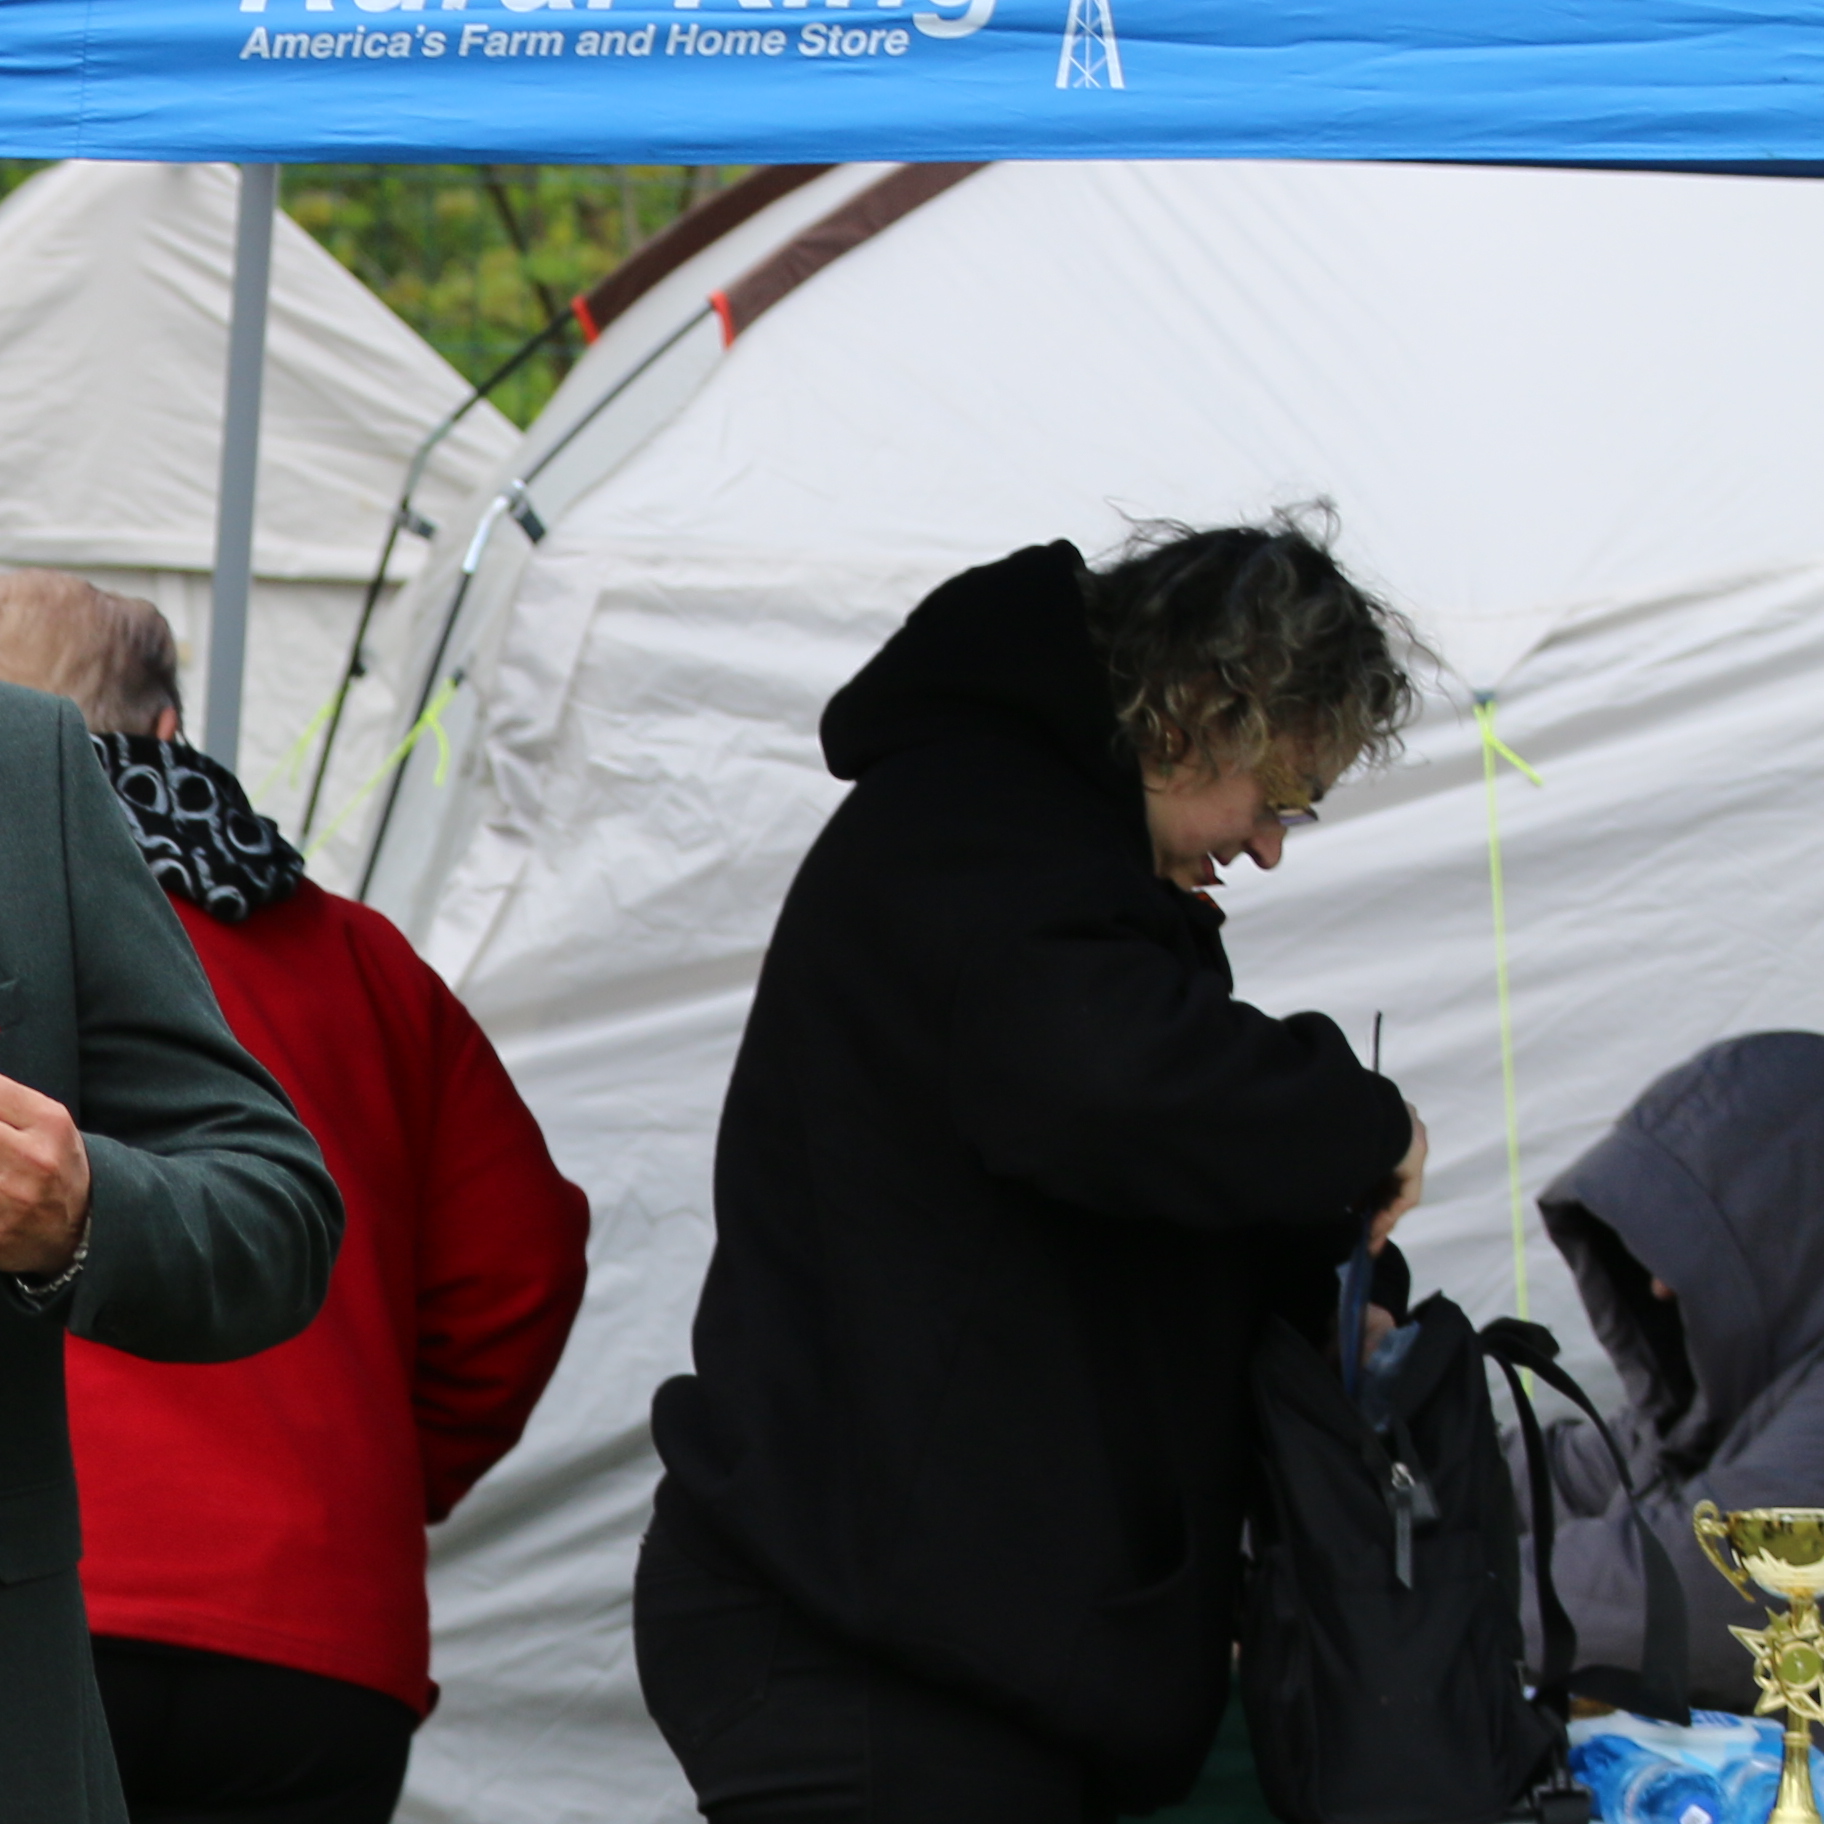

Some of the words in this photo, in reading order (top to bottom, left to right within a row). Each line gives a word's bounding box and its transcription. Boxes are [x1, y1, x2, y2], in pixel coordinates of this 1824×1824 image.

[239, 24, 447, 60] America's
[458, 23, 565, 57] Farm
[575, 23, 656, 57] and
[665, 23, 787, 56] Home
[797, 23, 909, 57] Store
